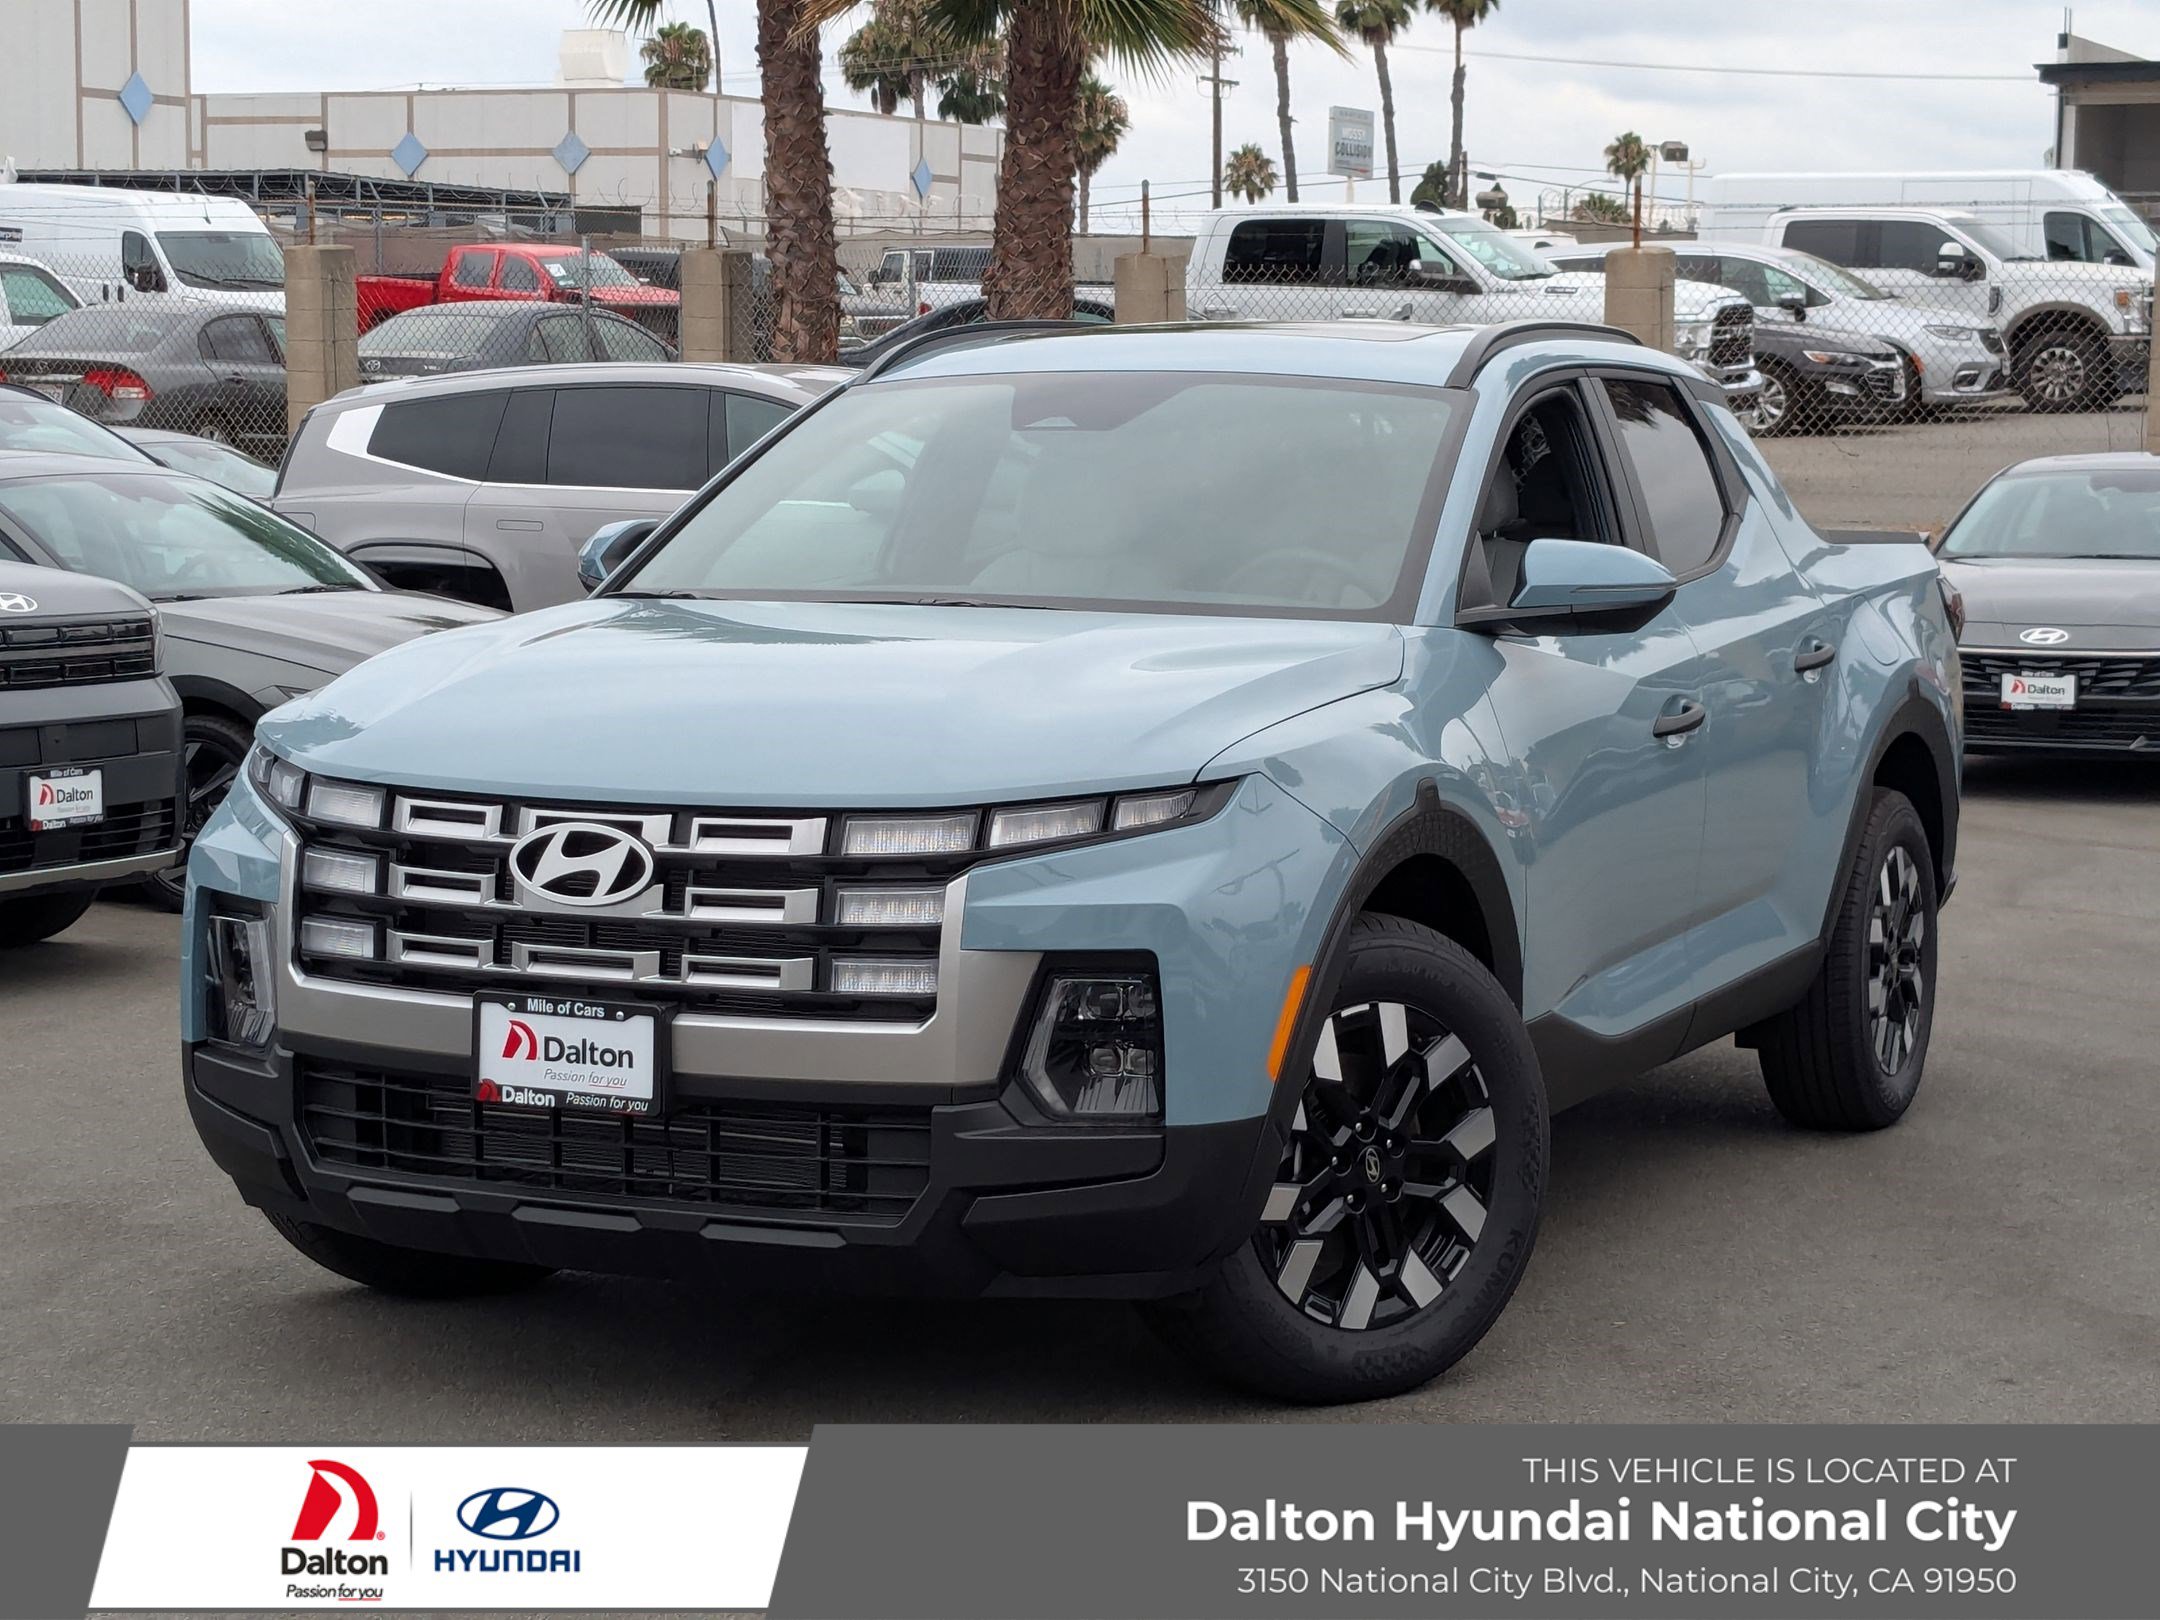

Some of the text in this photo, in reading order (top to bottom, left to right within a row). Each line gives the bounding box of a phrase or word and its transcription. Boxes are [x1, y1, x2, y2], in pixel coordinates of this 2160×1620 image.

[2027, 683, 2066, 695] Dalton
[56, 786, 94, 804] Dalton
[527, 998, 605, 1018] Mile of Cars
[544, 1035, 634, 1069] Dalton
[544, 1068, 629, 1088] Passion for you
[502, 1085, 649, 1112] Dalton Passion for you
